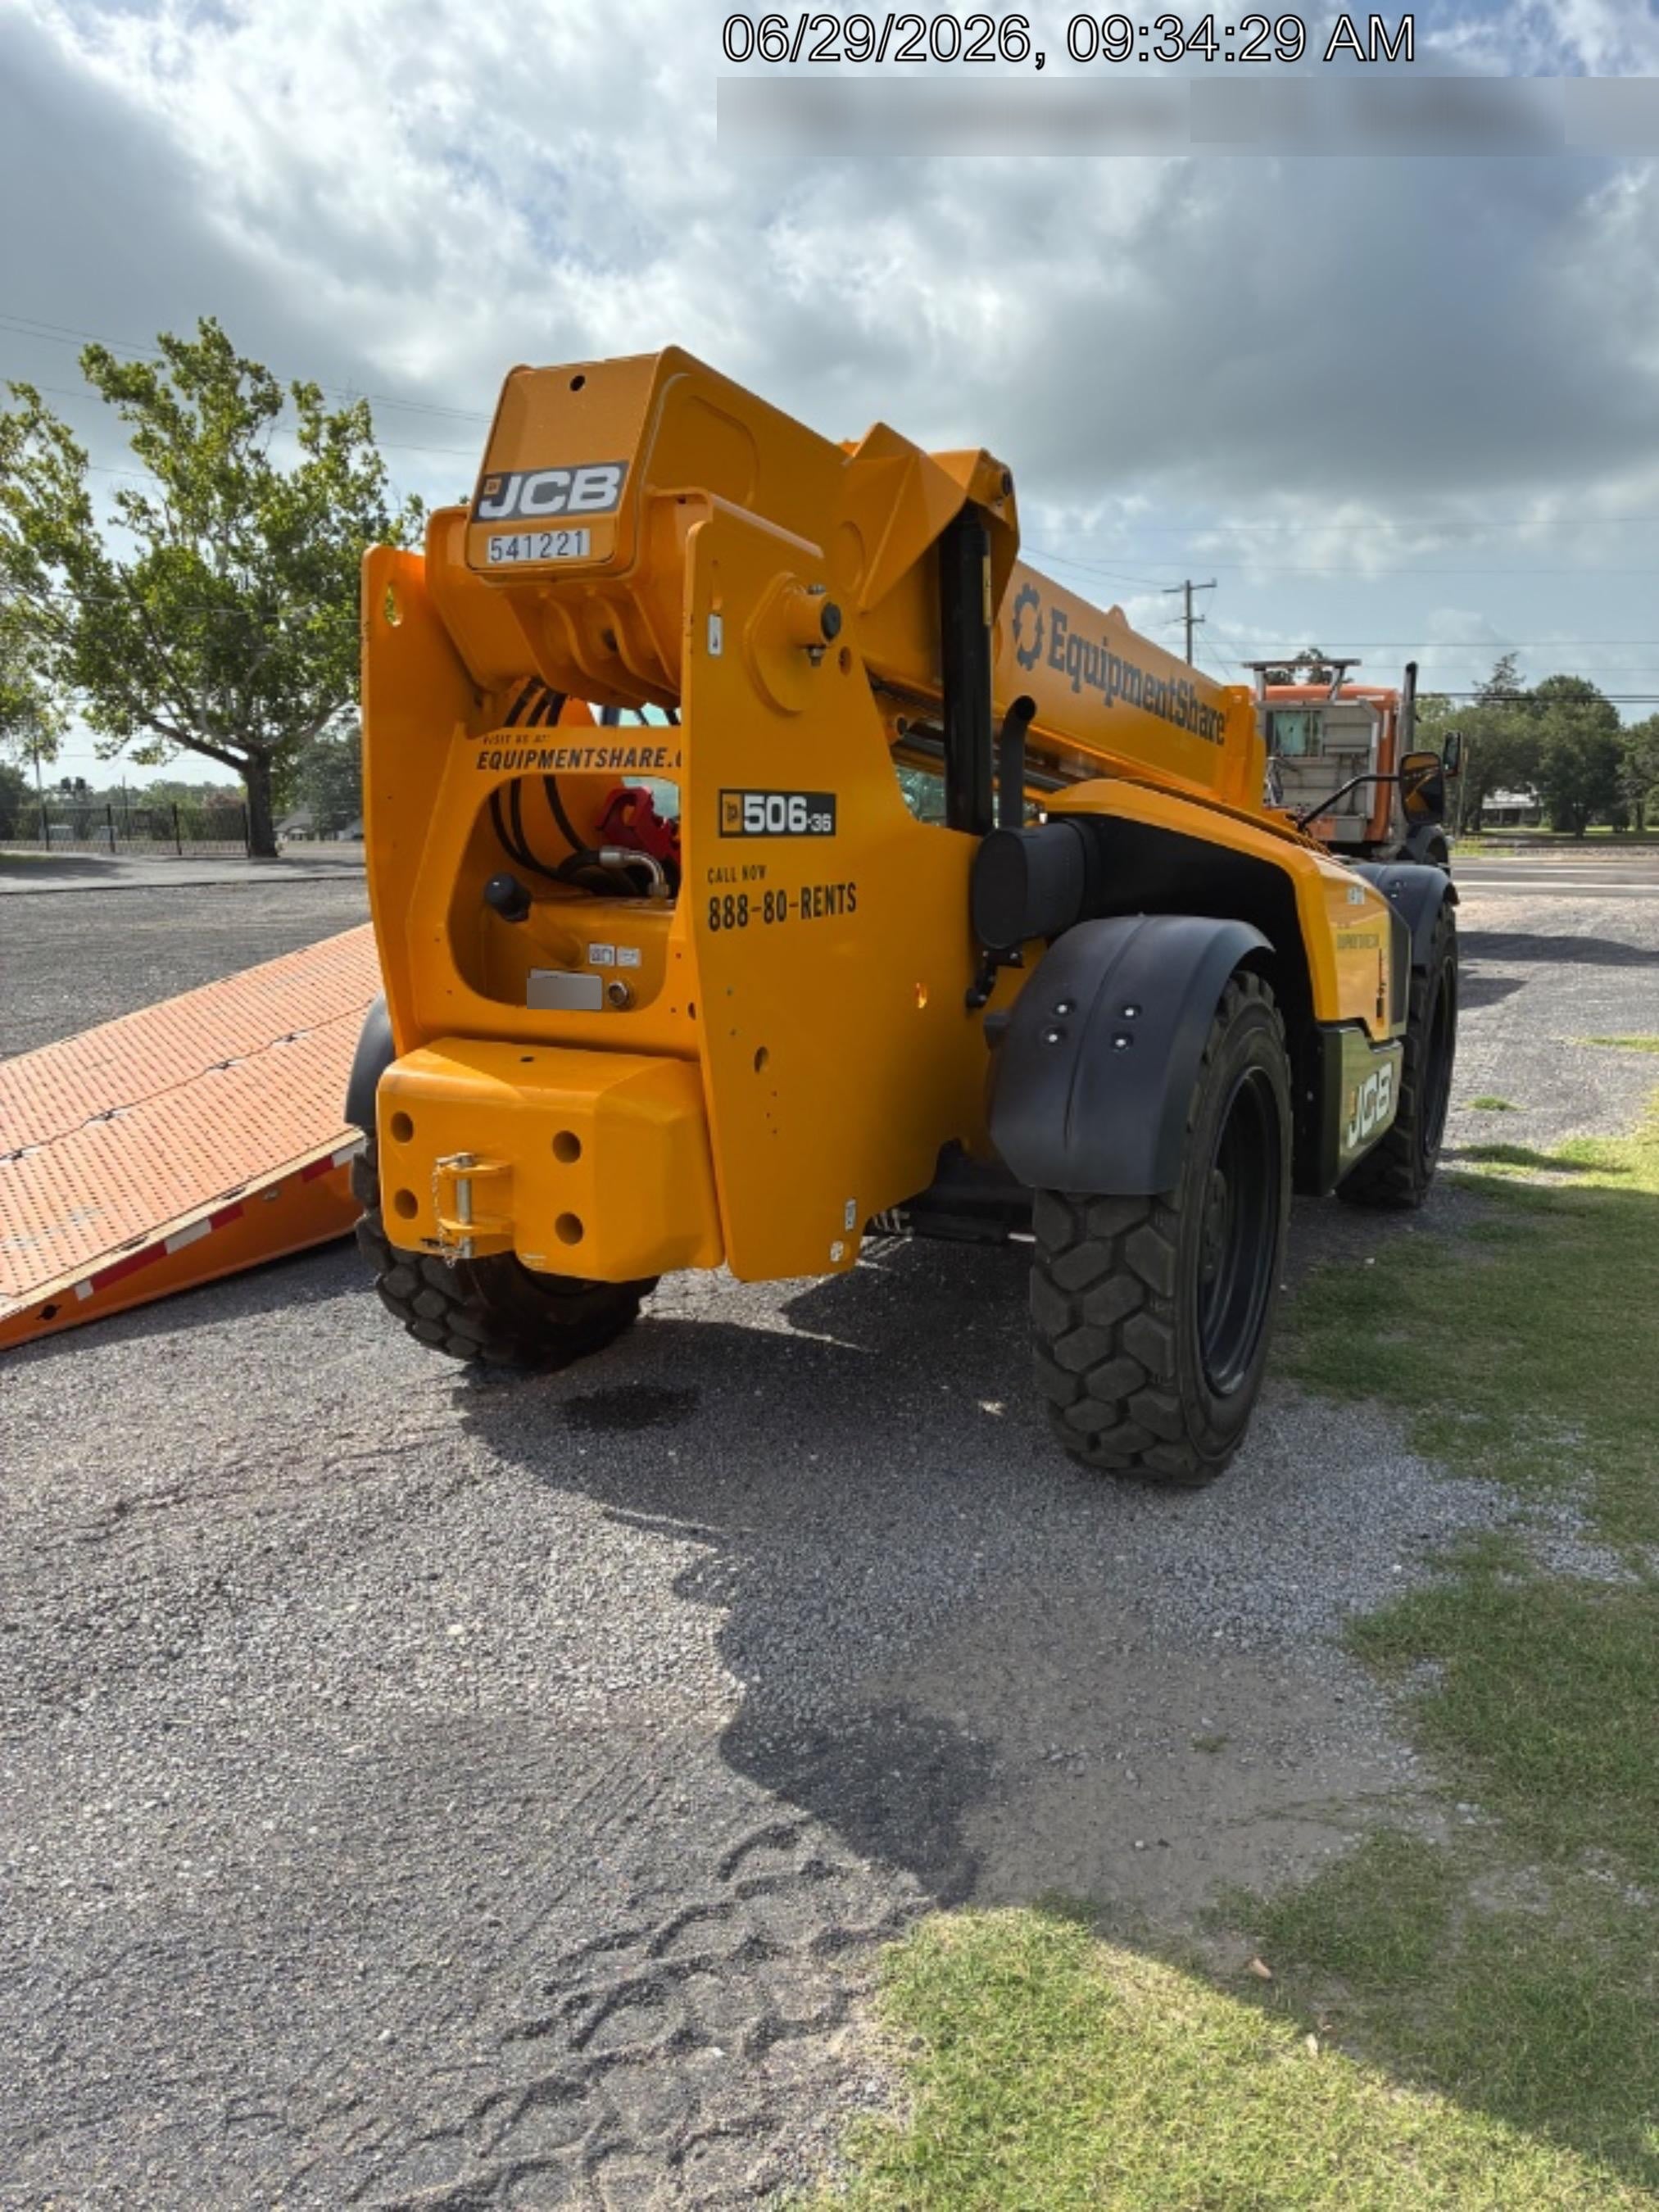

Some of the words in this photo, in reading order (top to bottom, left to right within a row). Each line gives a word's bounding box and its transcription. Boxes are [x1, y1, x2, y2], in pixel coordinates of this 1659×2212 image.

[478, 466, 621, 518] JCB
[491, 530, 584, 561] 541221
[1047, 606, 1226, 746] EquipmentShare
[707, 868, 737, 885] CALL
[742, 865, 768, 881] NOW
[709, 882, 857, 931] 888-80-RENTS
[1347, 1061, 1393, 1149] JCB
